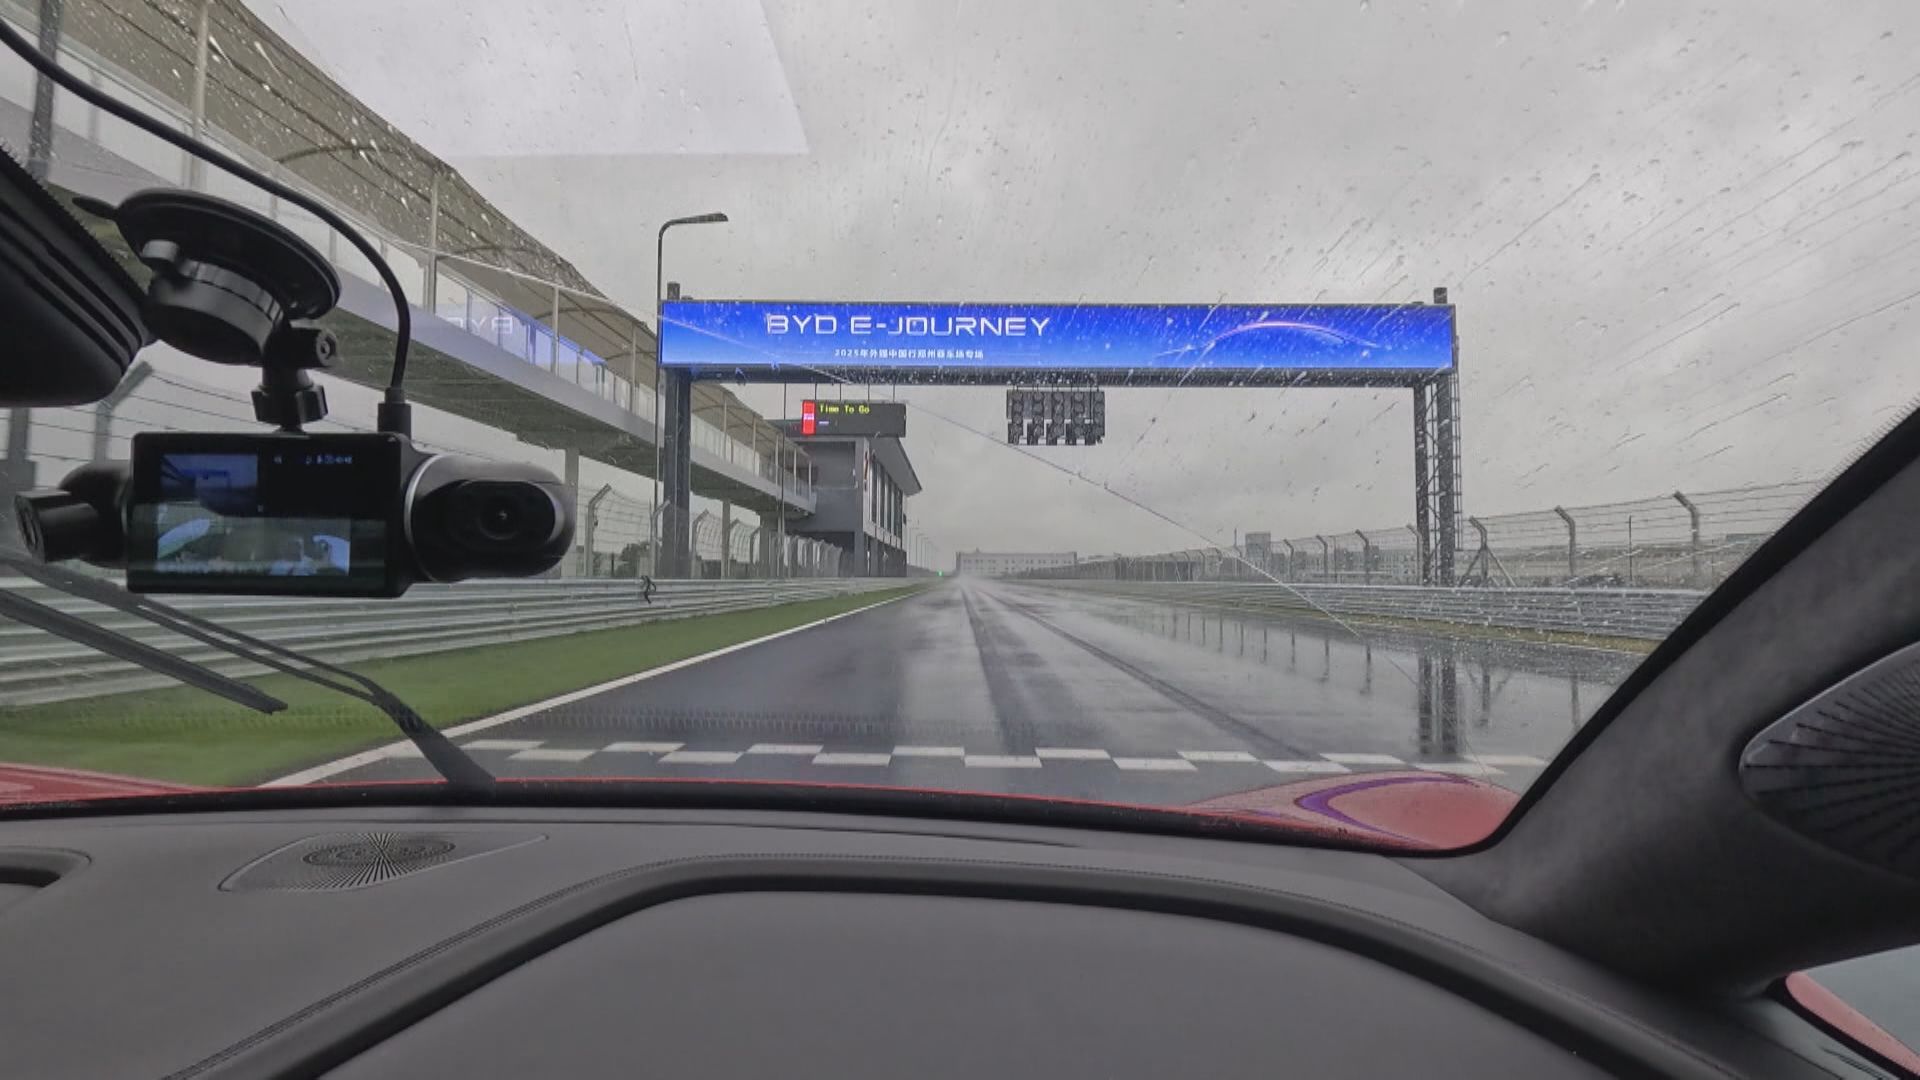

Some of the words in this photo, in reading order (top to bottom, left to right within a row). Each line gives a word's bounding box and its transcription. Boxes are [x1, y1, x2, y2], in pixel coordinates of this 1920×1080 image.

[766, 314, 837, 335] BYD
[850, 316, 1050, 336] E-JOURNEY
[819, 403, 839, 414] Time
[844, 404, 855, 415] To
[858, 404, 870, 415] Go
